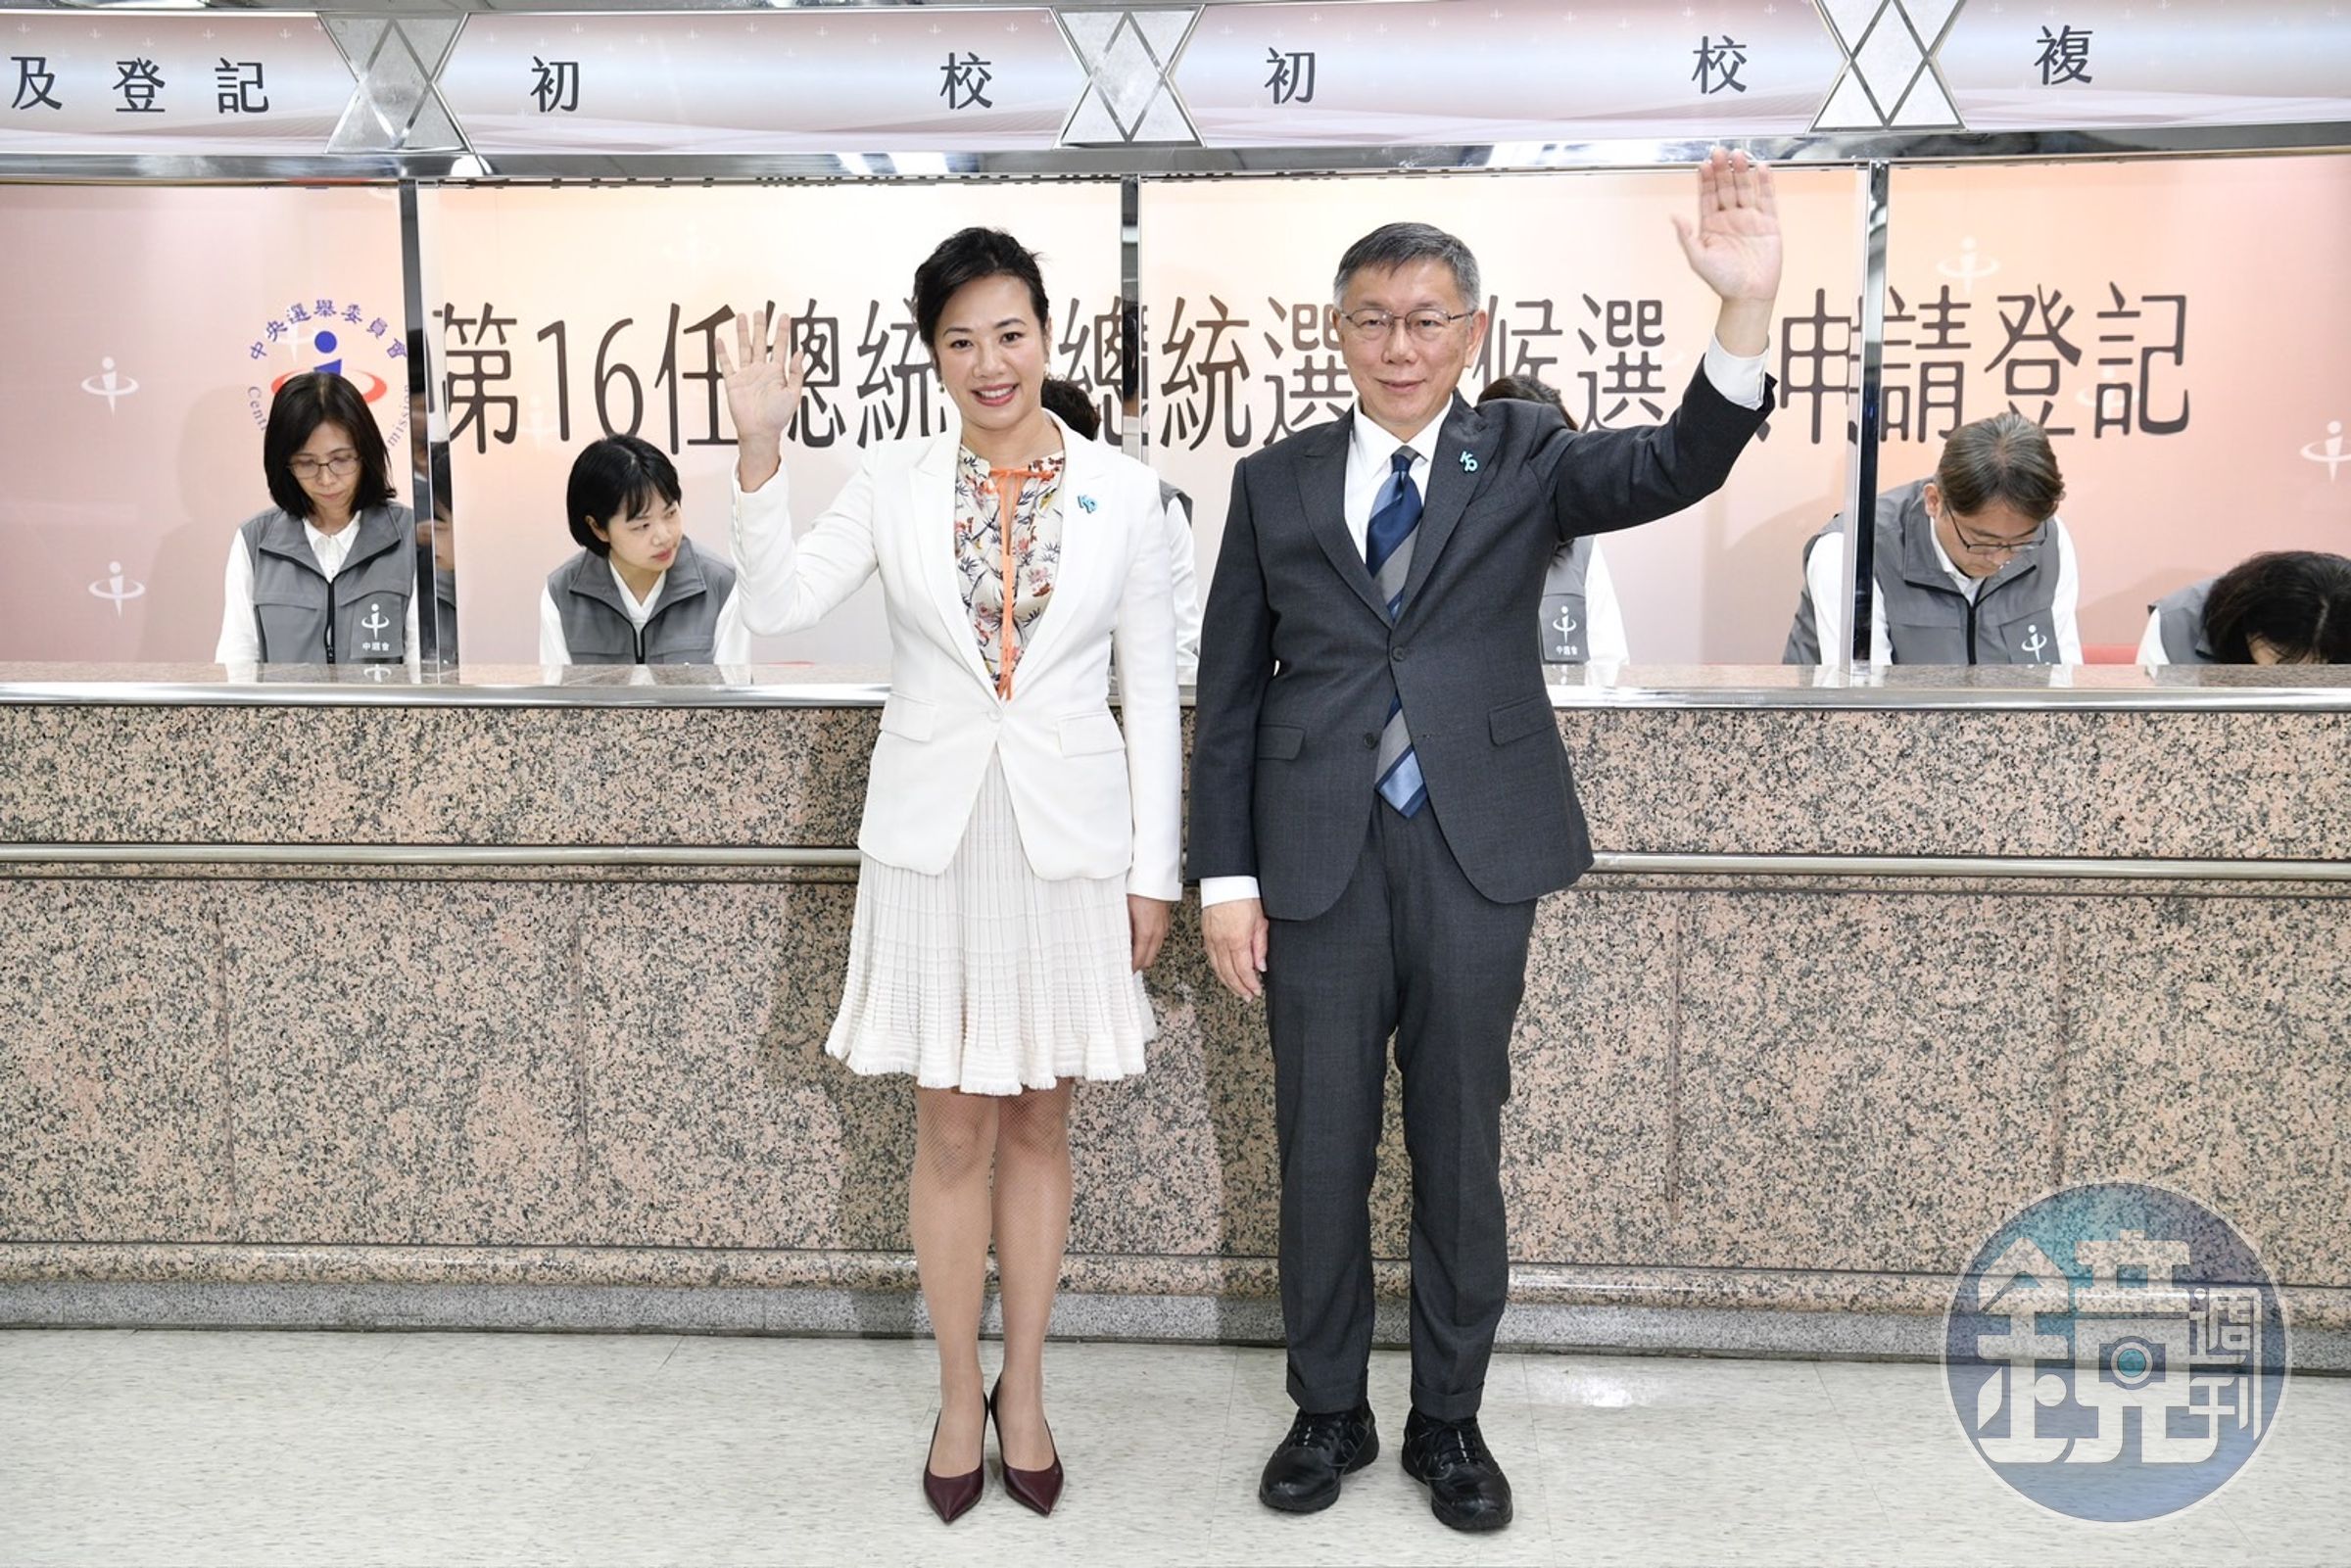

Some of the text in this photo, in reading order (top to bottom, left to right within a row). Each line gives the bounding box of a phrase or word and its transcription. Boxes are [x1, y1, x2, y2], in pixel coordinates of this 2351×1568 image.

[9, 55, 270, 115] 及登記
[2034, 24, 2094, 86] 複
[250, 299, 408, 361] 中央選舉委員會
